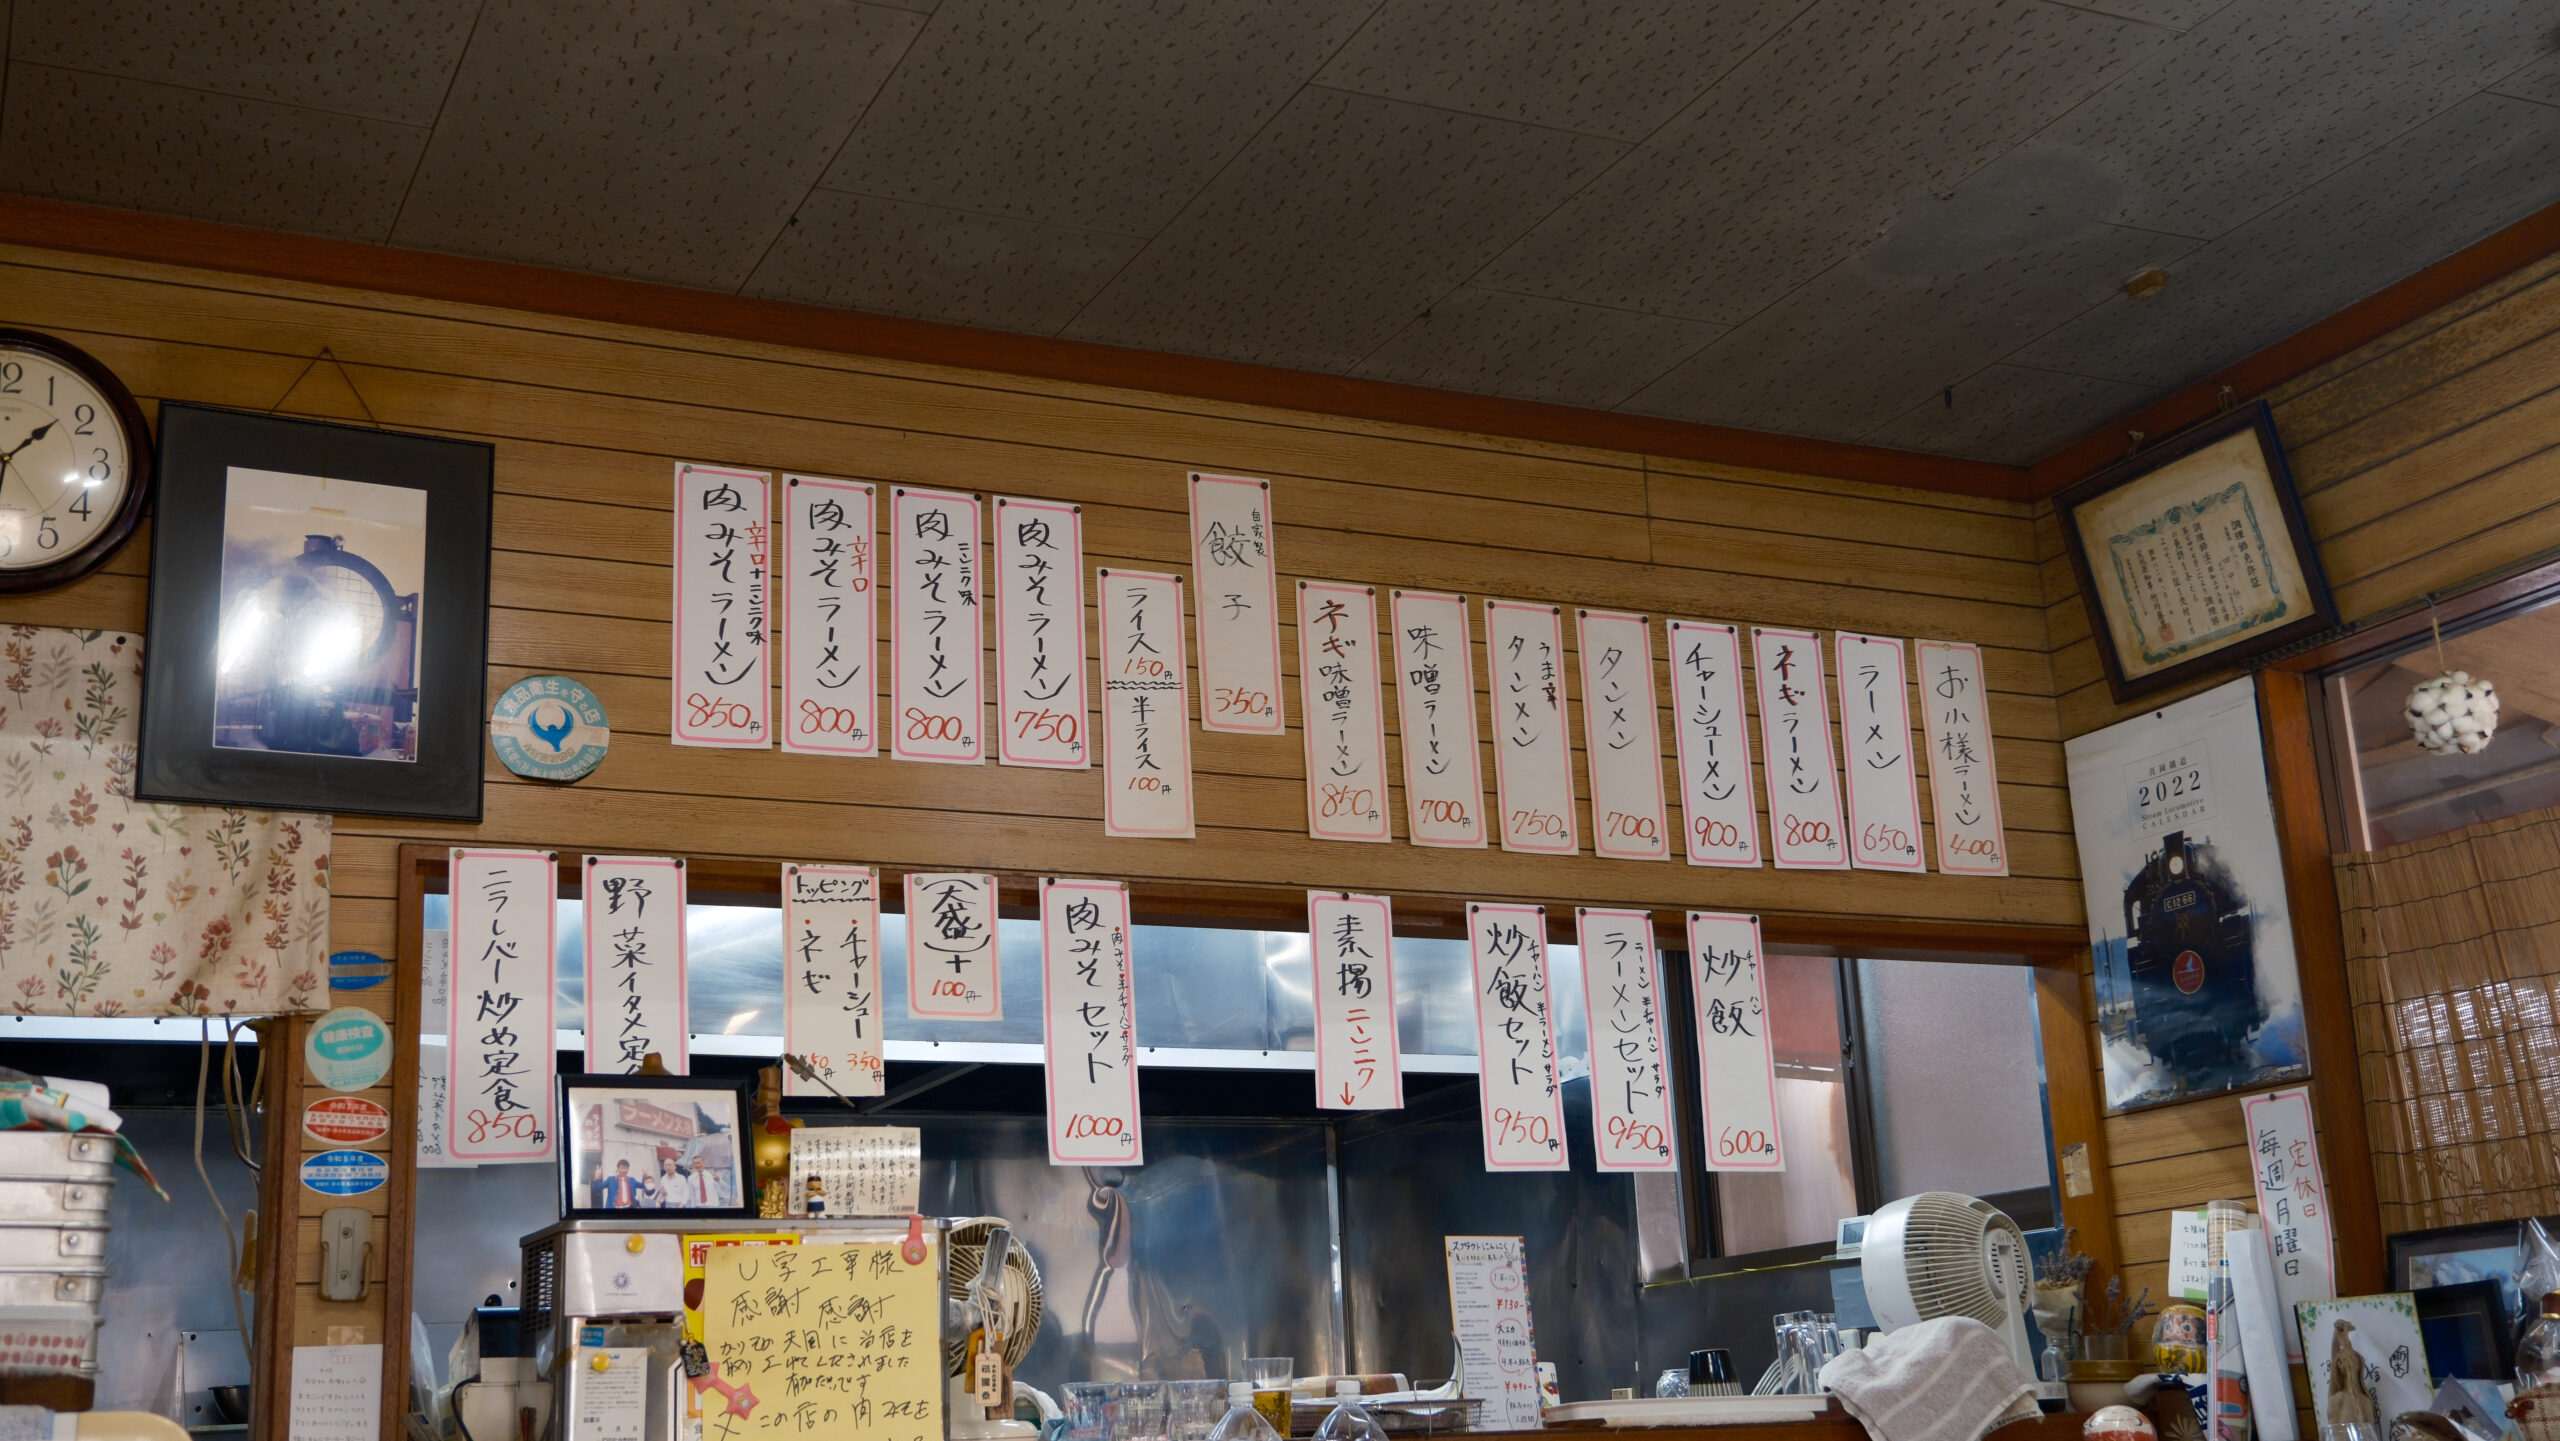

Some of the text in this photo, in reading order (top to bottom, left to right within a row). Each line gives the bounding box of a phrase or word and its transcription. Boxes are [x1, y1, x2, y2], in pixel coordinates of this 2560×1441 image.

[48, 375, 55, 407] 1
[74, 404, 96, 436] 2
[89, 447, 111, 481] 3
[69, 489, 92, 521] 4
[37, 516, 59, 550] 5
[1250, 508, 1268, 558] 自家製
[702, 483, 758, 685] 肉みそラーメン
[846, 535, 869, 593] 辛口
[958, 543, 977, 606] ニンニク味
[1201, 521, 1254, 621] 餃子
[808, 499, 861, 689] 肉みそラーメン
[915, 508, 968, 698] 肉みそラーメン
[1017, 518, 1071, 699] 肉みそラーメン
[1125, 587, 1160, 654] ライス
[1123, 658, 1174, 680] 150円
[1313, 599, 1365, 777] ネギ味噌ラーメン
[1213, 687, 1276, 717] 350円
[1407, 625, 1452, 775] 味噌ラーメン
[1507, 635, 1541, 747] タンメン
[1599, 646, 1637, 750] タンメン
[687, 693, 763, 734] 850円
[800, 699, 868, 741] 800円
[906, 707, 975, 748] 800円
[1014, 708, 1083, 752] 750円
[1130, 696, 1162, 771] 半ライス
[1685, 643, 1736, 800] チャーシューメン
[1773, 644, 1819, 793] ネギラーメン
[1858, 665, 1901, 769] ラーメン
[1128, 776, 1172, 795] 100円
[1320, 783, 1381, 822] 850円
[2139, 770, 2201, 807] 2022
[1419, 799, 1473, 828] 700円
[1512, 808, 1569, 839] 750円
[1606, 811, 1661, 846] 700円
[2142, 798, 2204, 821] Steam Locomotive
[2142, 805, 2205, 829] CALENDAR
[1694, 816, 1750, 851] 900円
[1784, 813, 1838, 851] 800円
[1863, 823, 1917, 856] 650円
[1950, 834, 2002, 863] 400円
[795, 875, 870, 895] トッピング
[796, 929, 830, 994] ネギ
[840, 926, 871, 1039] チャーシュー
[476, 870, 531, 1112] ニラレバー炒め定食
[931, 979, 982, 1003] 100円
[1065, 896, 1113, 1083] 肉みそセット
[1486, 922, 1539, 1085] 炒飯セット
[1702, 945, 1756, 1036] 炒飯
[1604, 932, 1648, 1114] ラーメンセット
[804, 1052, 837, 1080] 50円
[847, 1051, 885, 1082] 350円
[467, 1109, 546, 1144] 850円
[1494, 1108, 1561, 1152] 950円
[1608, 1116, 1670, 1157] 950円
[1720, 1126, 1776, 1158] 600円
[2288, 1140, 2318, 1219] 定休日
[2256, 1129, 2302, 1277] 毎週月曜日
[738, 1250, 904, 1282] U字工事様
[731, 1286, 896, 1329] 感謝 感謝
